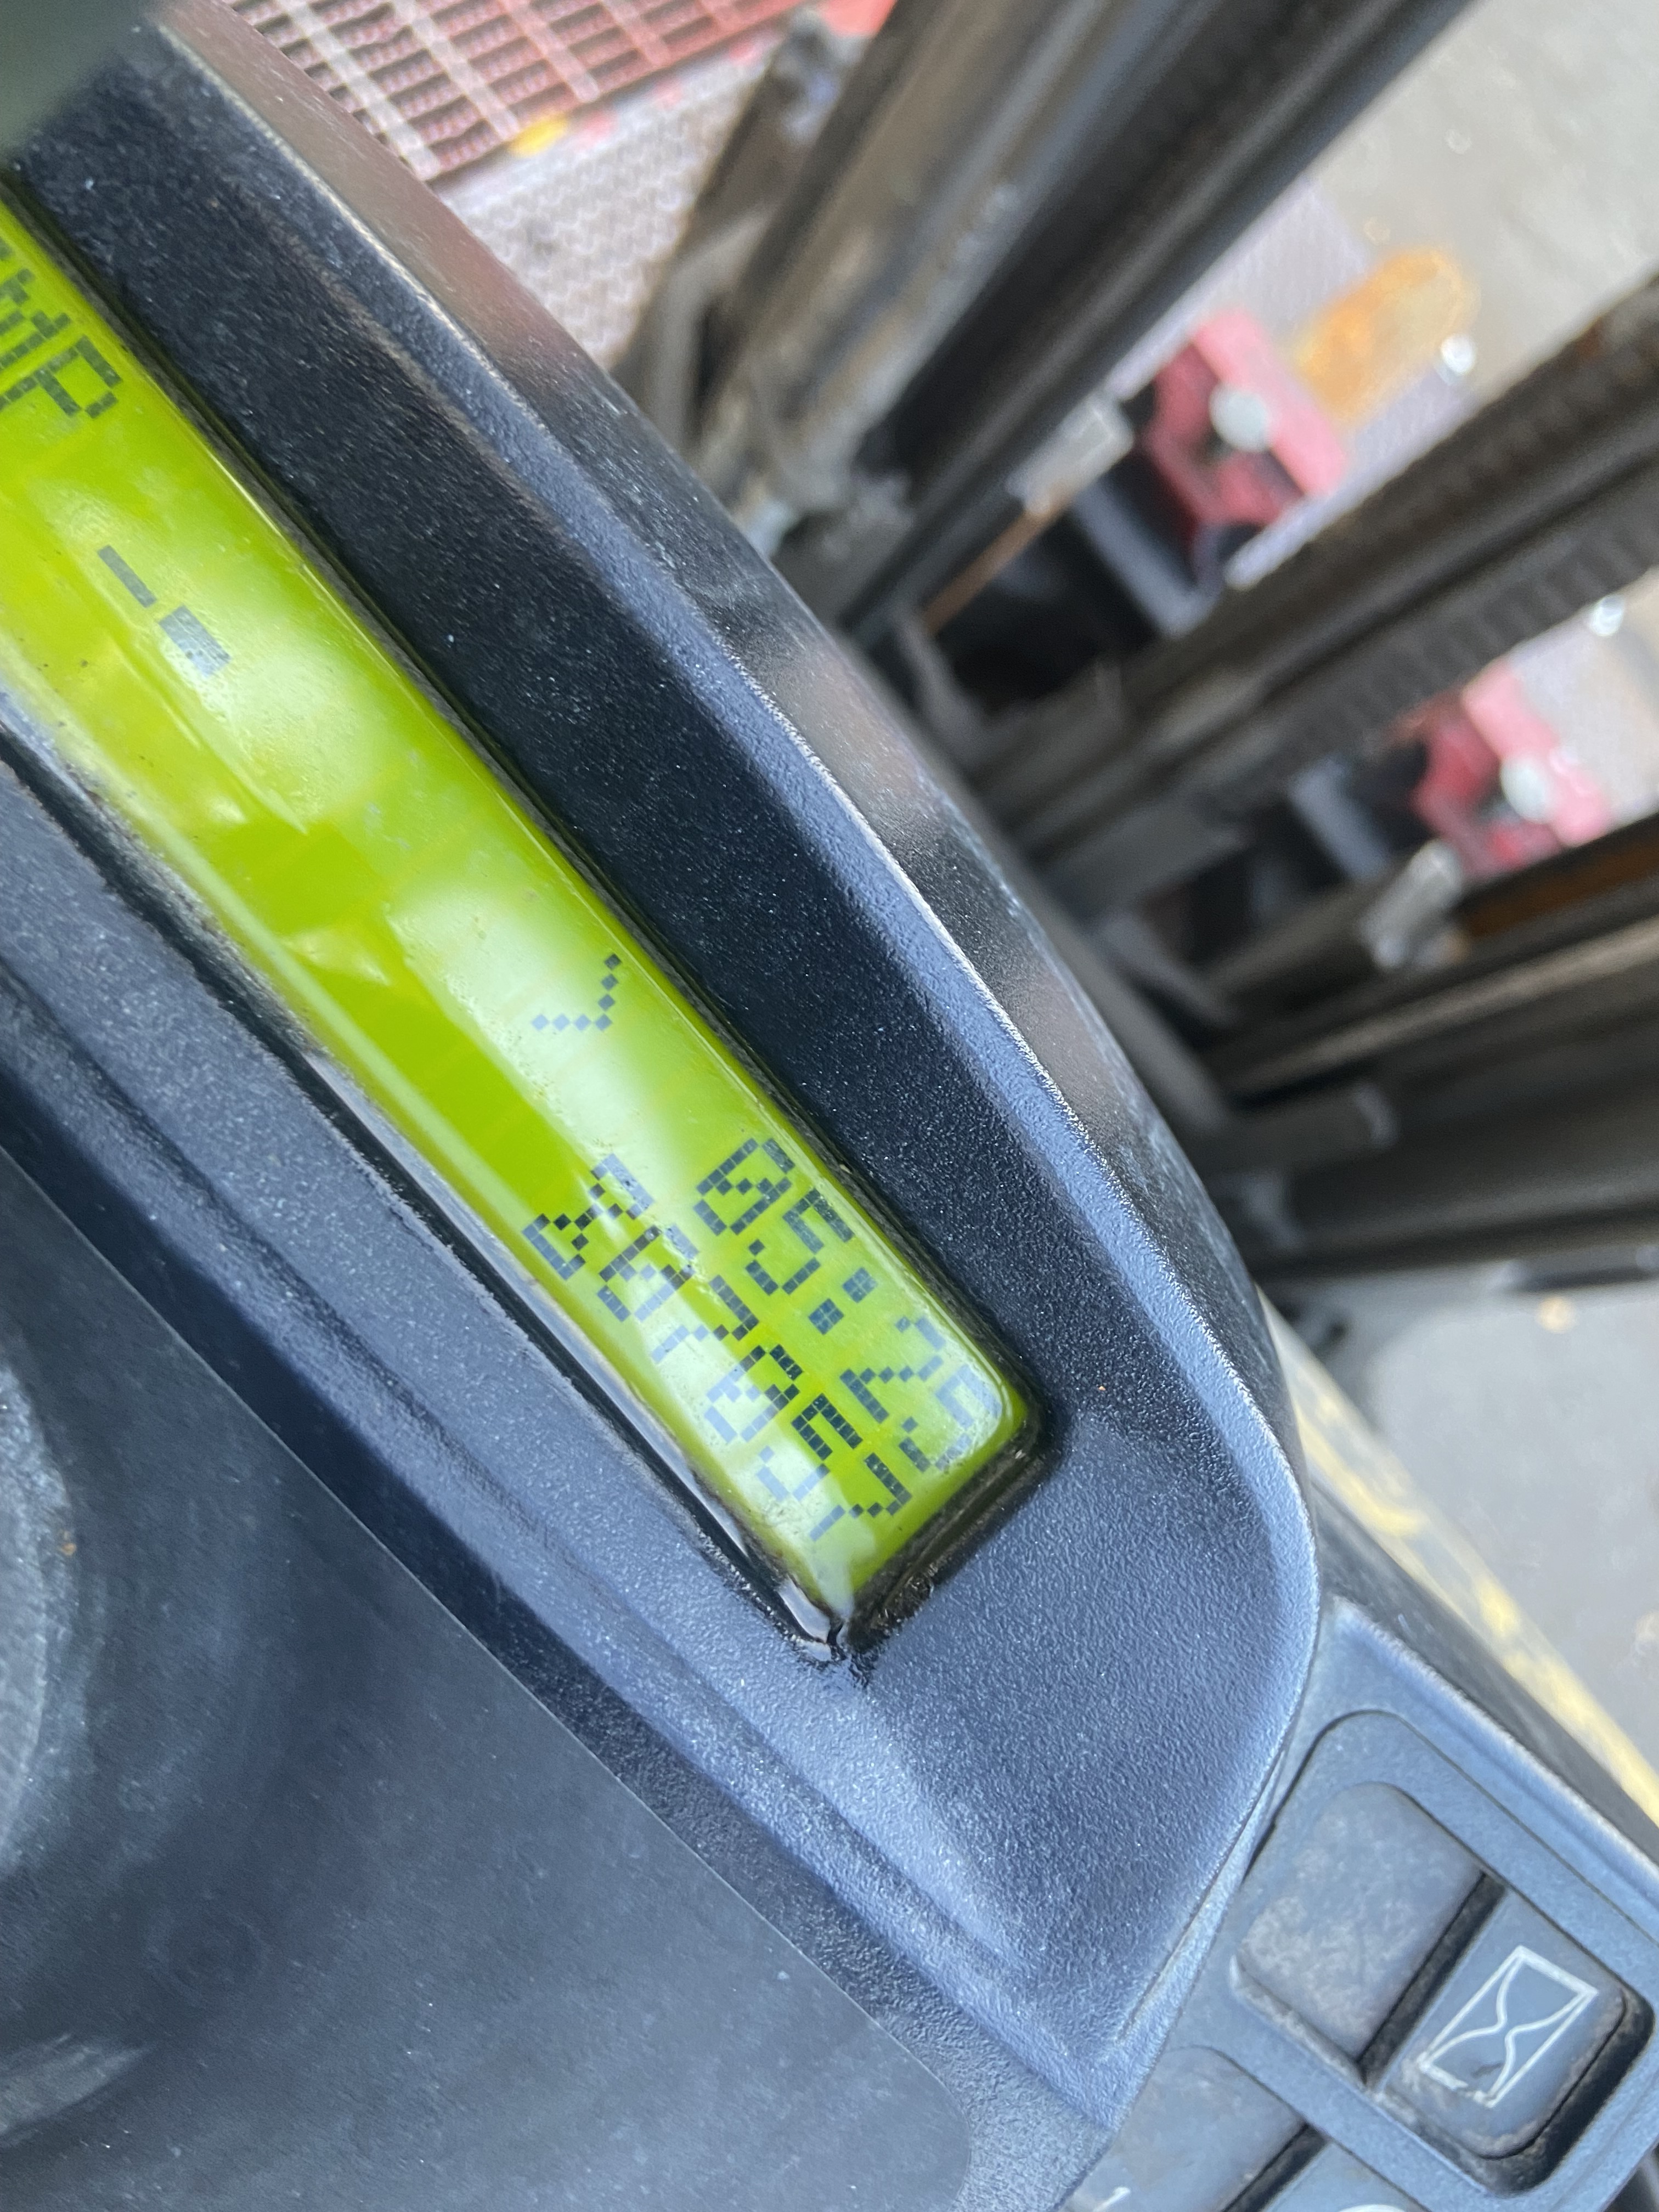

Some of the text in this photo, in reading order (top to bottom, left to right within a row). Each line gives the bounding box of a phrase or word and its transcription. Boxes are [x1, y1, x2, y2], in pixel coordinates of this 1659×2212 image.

[0, 237, 121, 417] MP
[597, 1225, 912, 1541] 07057
[695, 1138, 1003, 1472] 05:25
